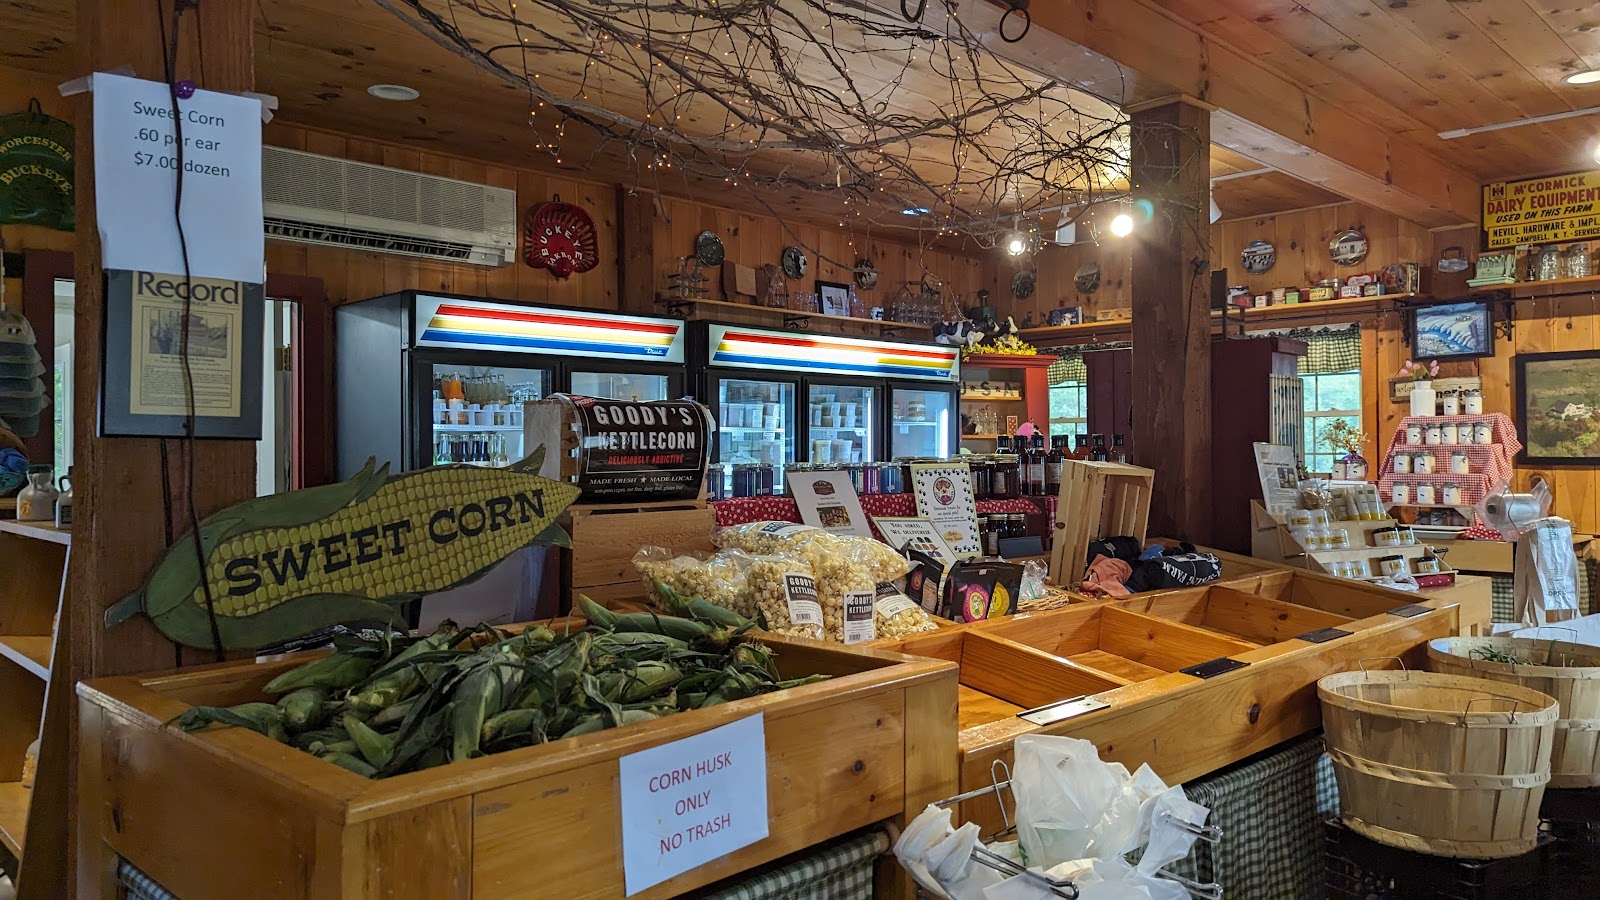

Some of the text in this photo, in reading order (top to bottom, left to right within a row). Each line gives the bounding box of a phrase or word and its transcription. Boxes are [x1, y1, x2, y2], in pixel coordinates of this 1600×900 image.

[188, 110, 224, 127] Corn
[134, 128, 159, 142] .60
[195, 139, 221, 151] ear
[134, 151, 230, 177] $7.00 dozen
[0, 165, 73, 194] BUCKEYE
[1487, 187, 1600, 215] DAIRY EQUIPMENT
[1496, 203, 1593, 224] USED ON THIS FARM
[1491, 237, 1511, 246] SALES
[1574, 227, 1600, 237] SERVICE
[1492, 226, 1519, 238] NEVILL
[1523, 221, 1565, 234] HARDWARE
[1569, 220, 1575, 228] &
[540, 225, 583, 260] BUCKEYE
[137, 271, 239, 304] Record
[593, 405, 693, 426] GOODY'S
[598, 432, 695, 450] KETTLECORN
[608, 454, 684, 465] DELICIOUSLY ADDICTIVE
[224, 489, 545, 597] SWEET CORN
[649, 751, 732, 793] CORN HUSK
[675, 790, 711, 816] ONLY
[660, 813, 731, 855] NO TRASH
